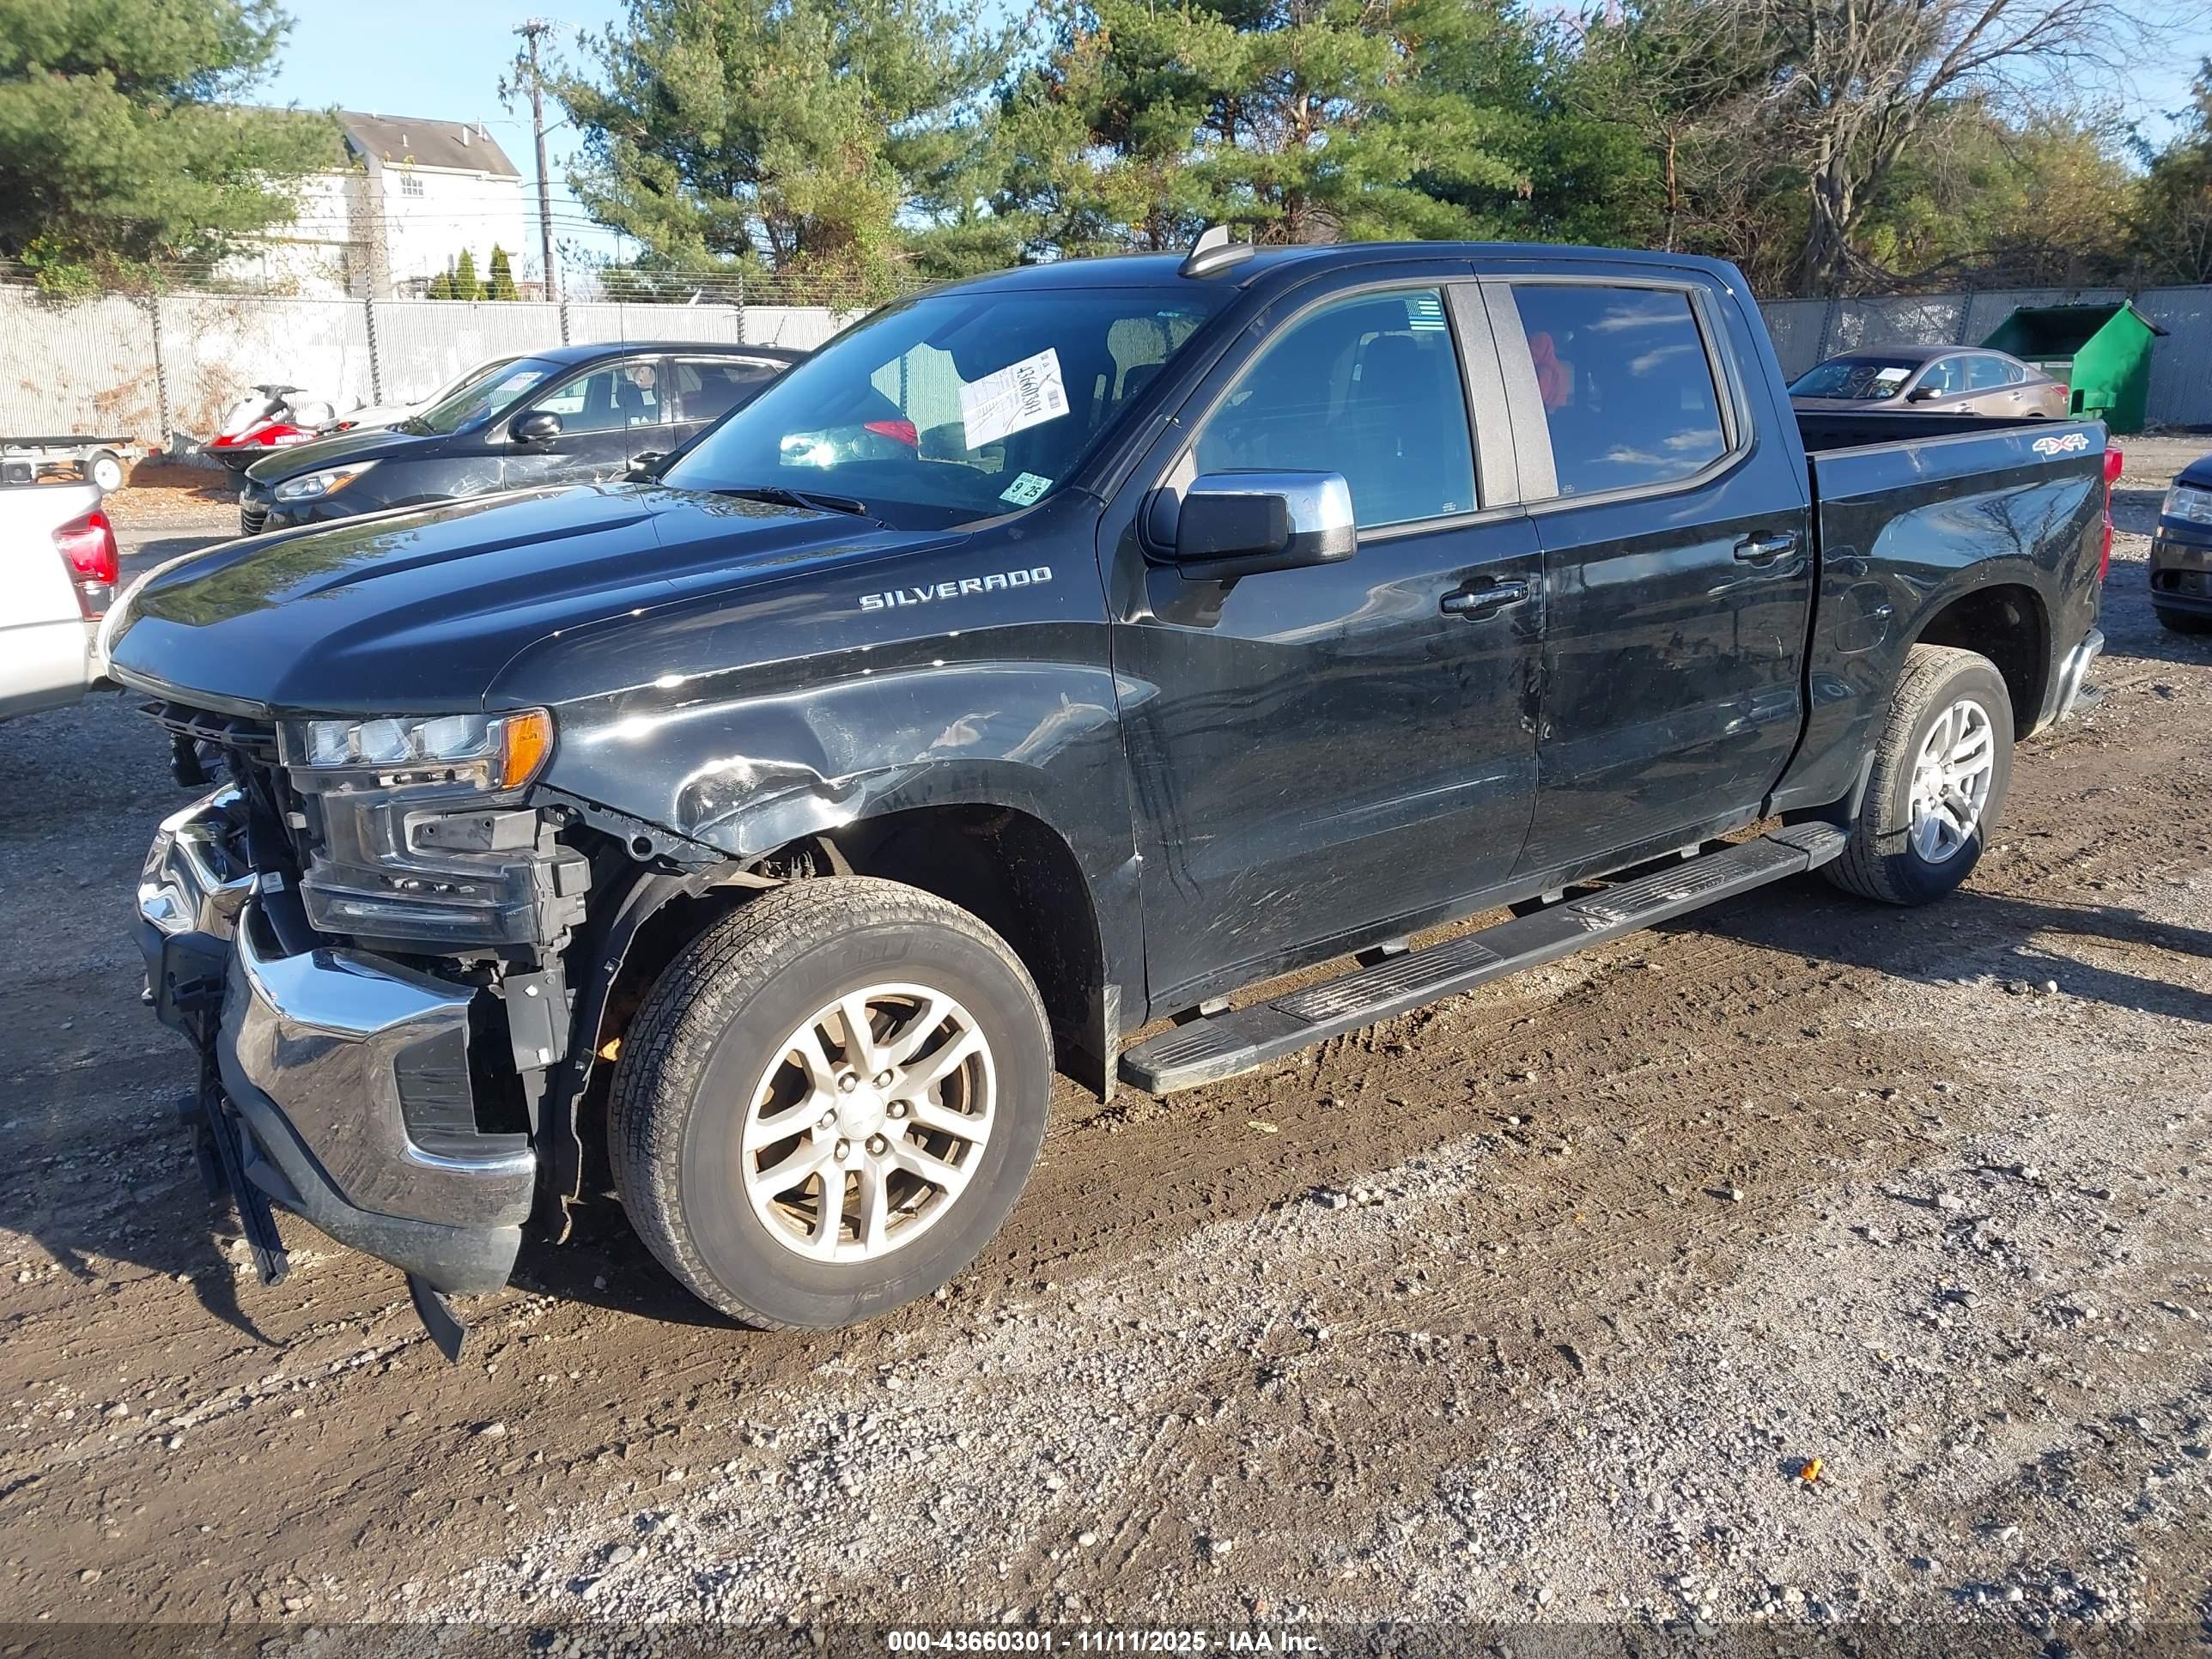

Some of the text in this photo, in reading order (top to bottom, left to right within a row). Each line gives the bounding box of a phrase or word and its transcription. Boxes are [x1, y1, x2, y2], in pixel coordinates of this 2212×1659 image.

[1012, 482, 1042, 498] 9 25
[857, 566, 1054, 611] SILVERADO
